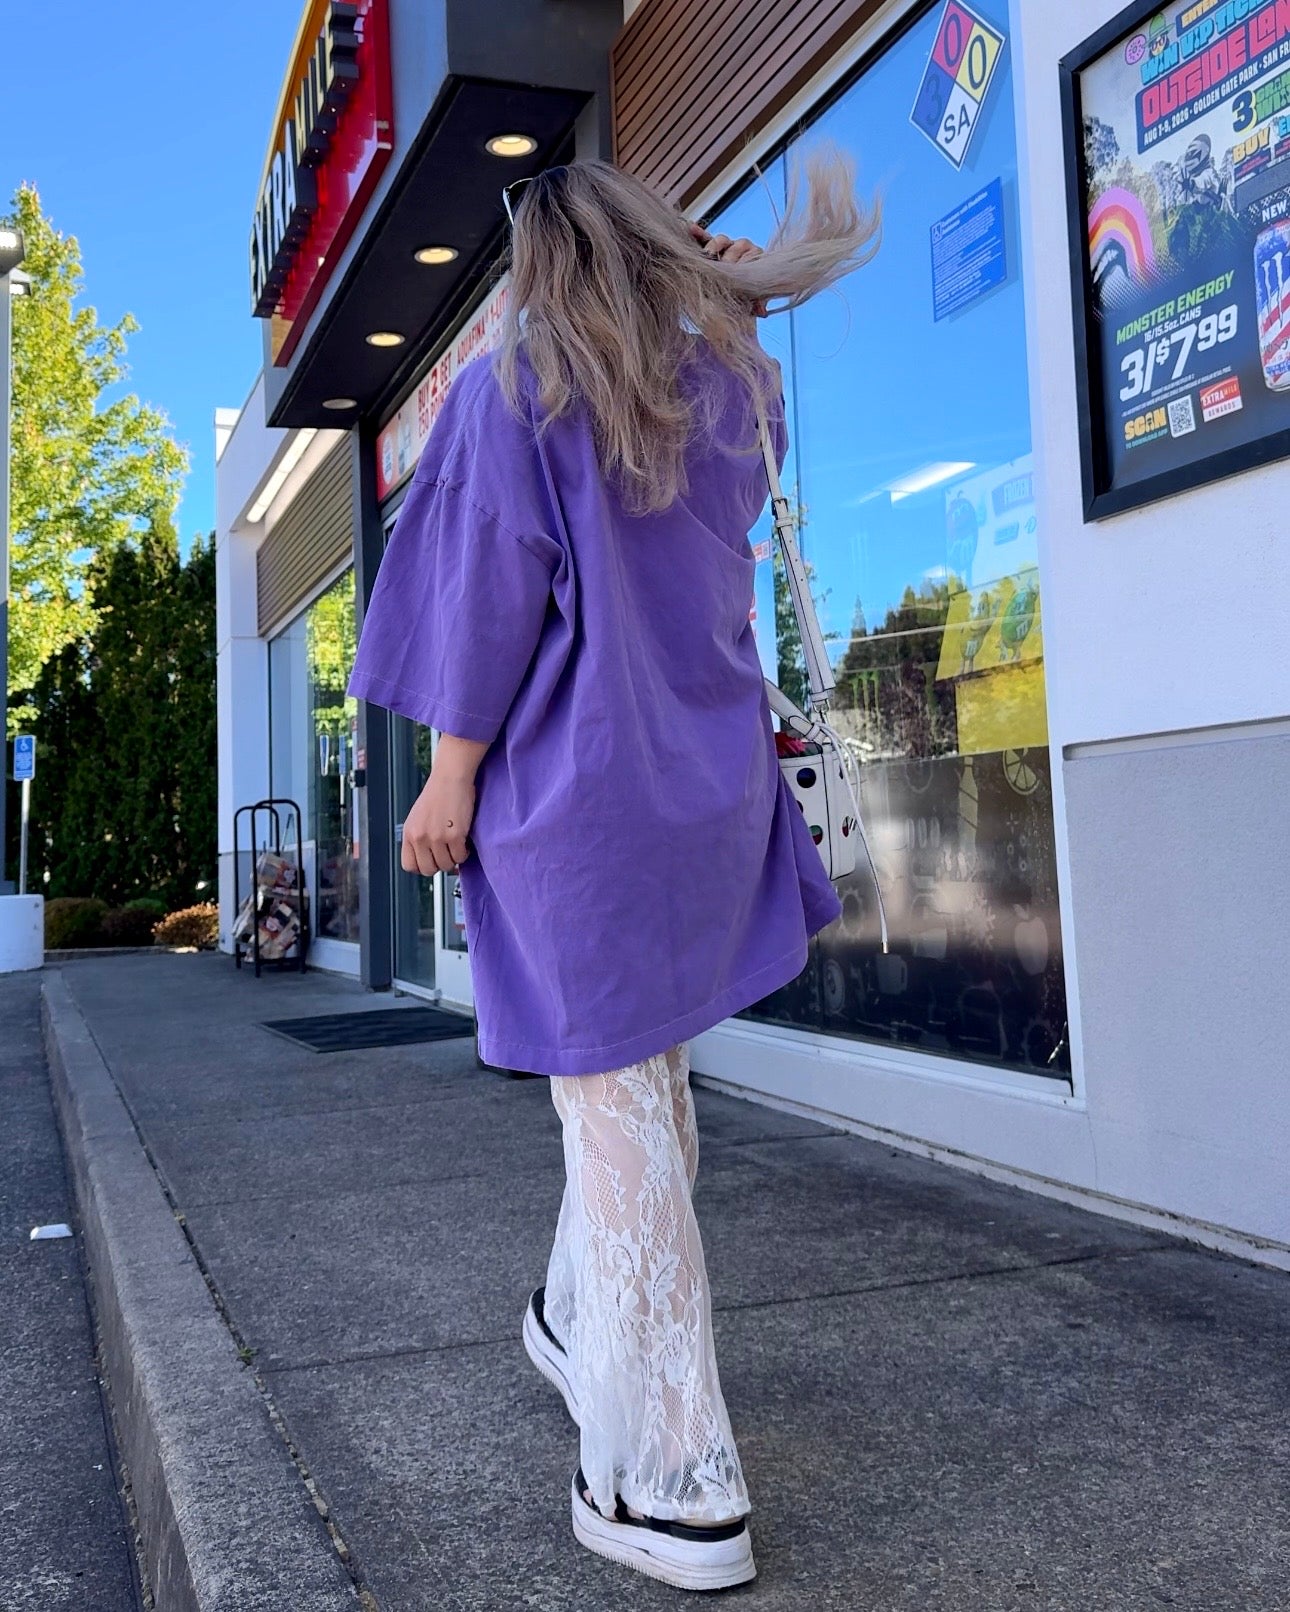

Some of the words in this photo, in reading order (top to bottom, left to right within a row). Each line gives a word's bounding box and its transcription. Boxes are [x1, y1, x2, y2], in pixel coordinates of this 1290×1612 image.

[967, 34, 987, 91] 0
[1140, 42, 1180, 86] WIN
[1142, 26, 1246, 128] OUTSIDE
[1144, 126, 1158, 147] AUG
[1193, 87, 1220, 115] GOLDEN
[1220, 75, 1238, 97] GATE
[1238, 61, 1259, 85] PARK
[1262, 47, 1278, 69] SAN
[1232, 89, 1256, 134] 3
[943, 102, 971, 145] SA
[1232, 126, 1271, 165] BUY
[249, 118, 303, 318] EXTRA
[1261, 199, 1287, 222] NEW
[1116, 300, 1175, 346] MONSTER
[1177, 270, 1235, 313] ENERGY
[1180, 305, 1202, 326] CANS
[431, 366, 438, 397] 2
[1201, 390, 1226, 407] EXTRA
[1124, 406, 1168, 441] SCAN
